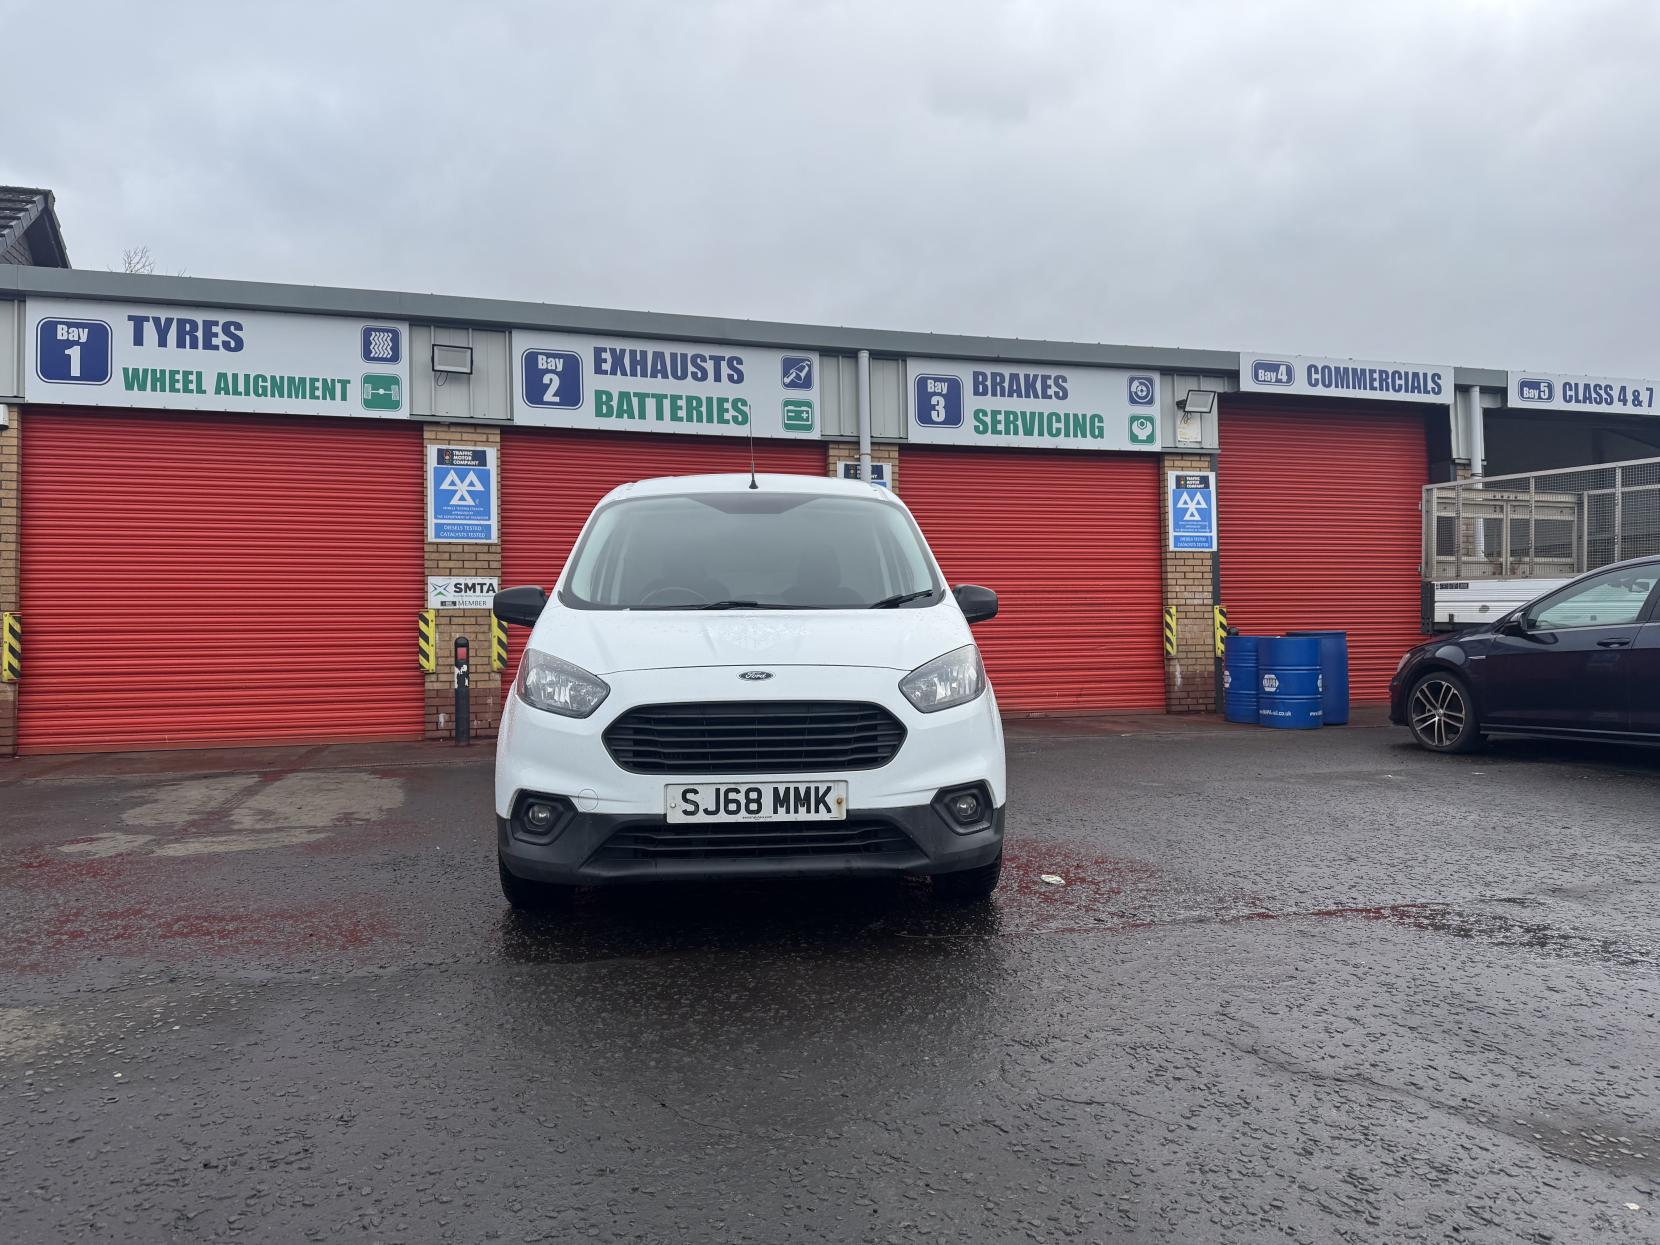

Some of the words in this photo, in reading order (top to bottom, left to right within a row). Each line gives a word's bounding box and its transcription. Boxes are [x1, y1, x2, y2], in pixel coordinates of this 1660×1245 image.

[57, 324, 89, 343] Bay
[127, 314, 245, 353] TYRES
[64, 345, 82, 377] 1
[537, 355, 564, 372] Bay
[593, 346, 745, 384] EXHAUSTS
[1258, 369, 1276, 384] Bay
[1277, 364, 1288, 383] 4
[122, 367, 207, 395] WHEEL
[215, 371, 351, 402] ALIGNMENT
[543, 373, 560, 403] 2
[927, 380, 948, 395] Bay
[972, 370, 1069, 401] BRAKES
[1306, 364, 1442, 396] COMMERCIALS
[1523, 386, 1540, 401] Bay
[1540, 382, 1550, 399] 5
[1562, 382, 1614, 406] CLASS
[1617, 386, 1628, 407] 4
[1631, 390, 1643, 408] &
[1646, 387, 1655, 408] 7
[594, 389, 749, 426] BATTERIES
[930, 395, 946, 423] 3
[973, 408, 1105, 439] SERVICING
[453, 582, 496, 594] SMTA
[681, 786, 763, 816] SJ68
[773, 785, 833, 815] MMK
